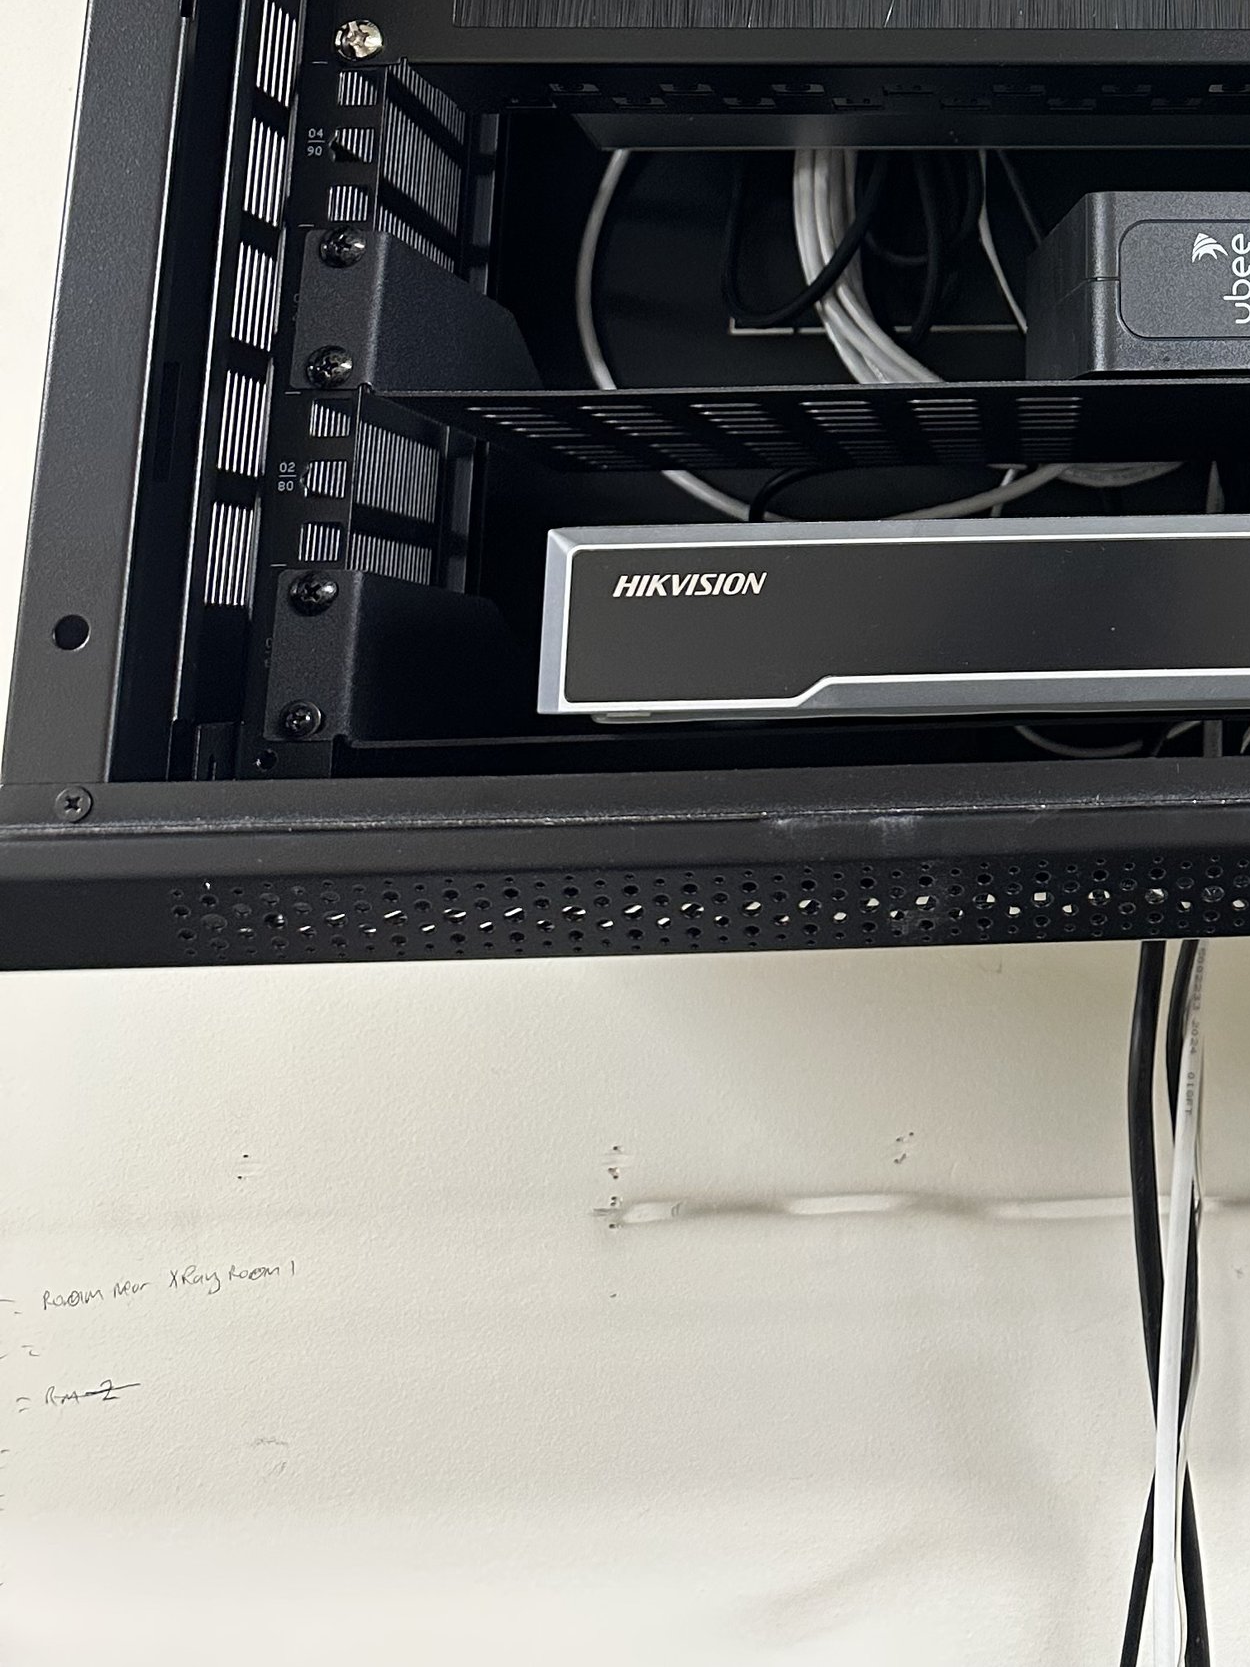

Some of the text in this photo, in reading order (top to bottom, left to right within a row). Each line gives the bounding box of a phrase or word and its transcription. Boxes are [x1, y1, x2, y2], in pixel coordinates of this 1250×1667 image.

[308, 128, 324, 139] 04
[279, 462, 296, 473] 02
[612, 572, 767, 598] HIKVISION
